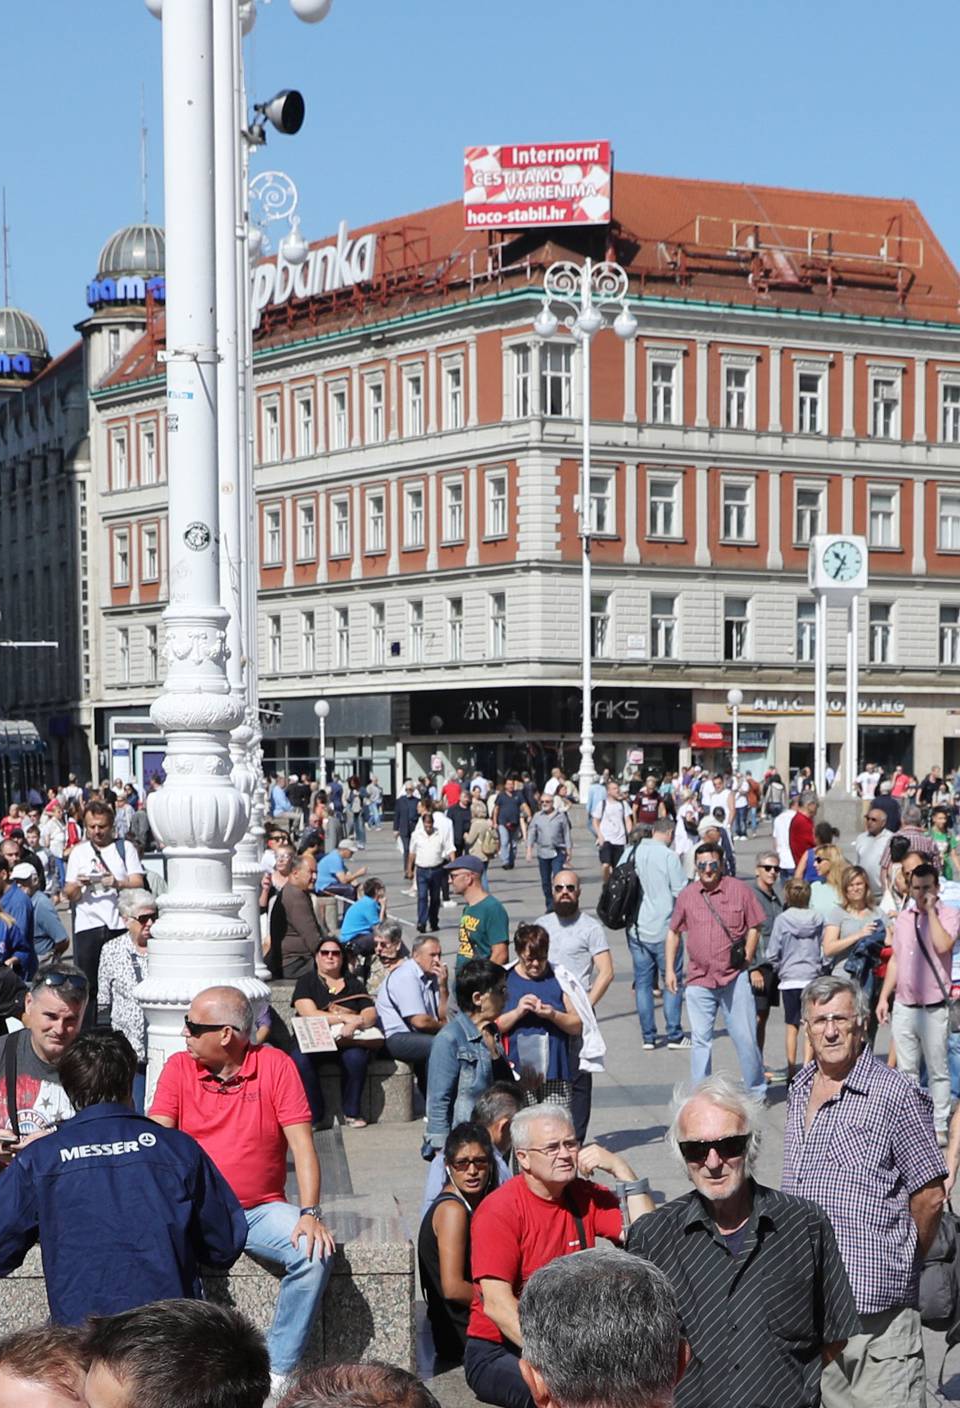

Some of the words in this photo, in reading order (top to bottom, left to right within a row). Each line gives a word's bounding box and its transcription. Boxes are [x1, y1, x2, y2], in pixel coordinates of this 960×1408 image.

[512, 145, 599, 165] Internorm
[473, 168, 563, 186] ČESTITAMO
[506, 185, 597, 201] VATRENIMA
[467, 205, 567, 225] hoco-stabil.hr
[60, 1140, 139, 1162] MESSER
